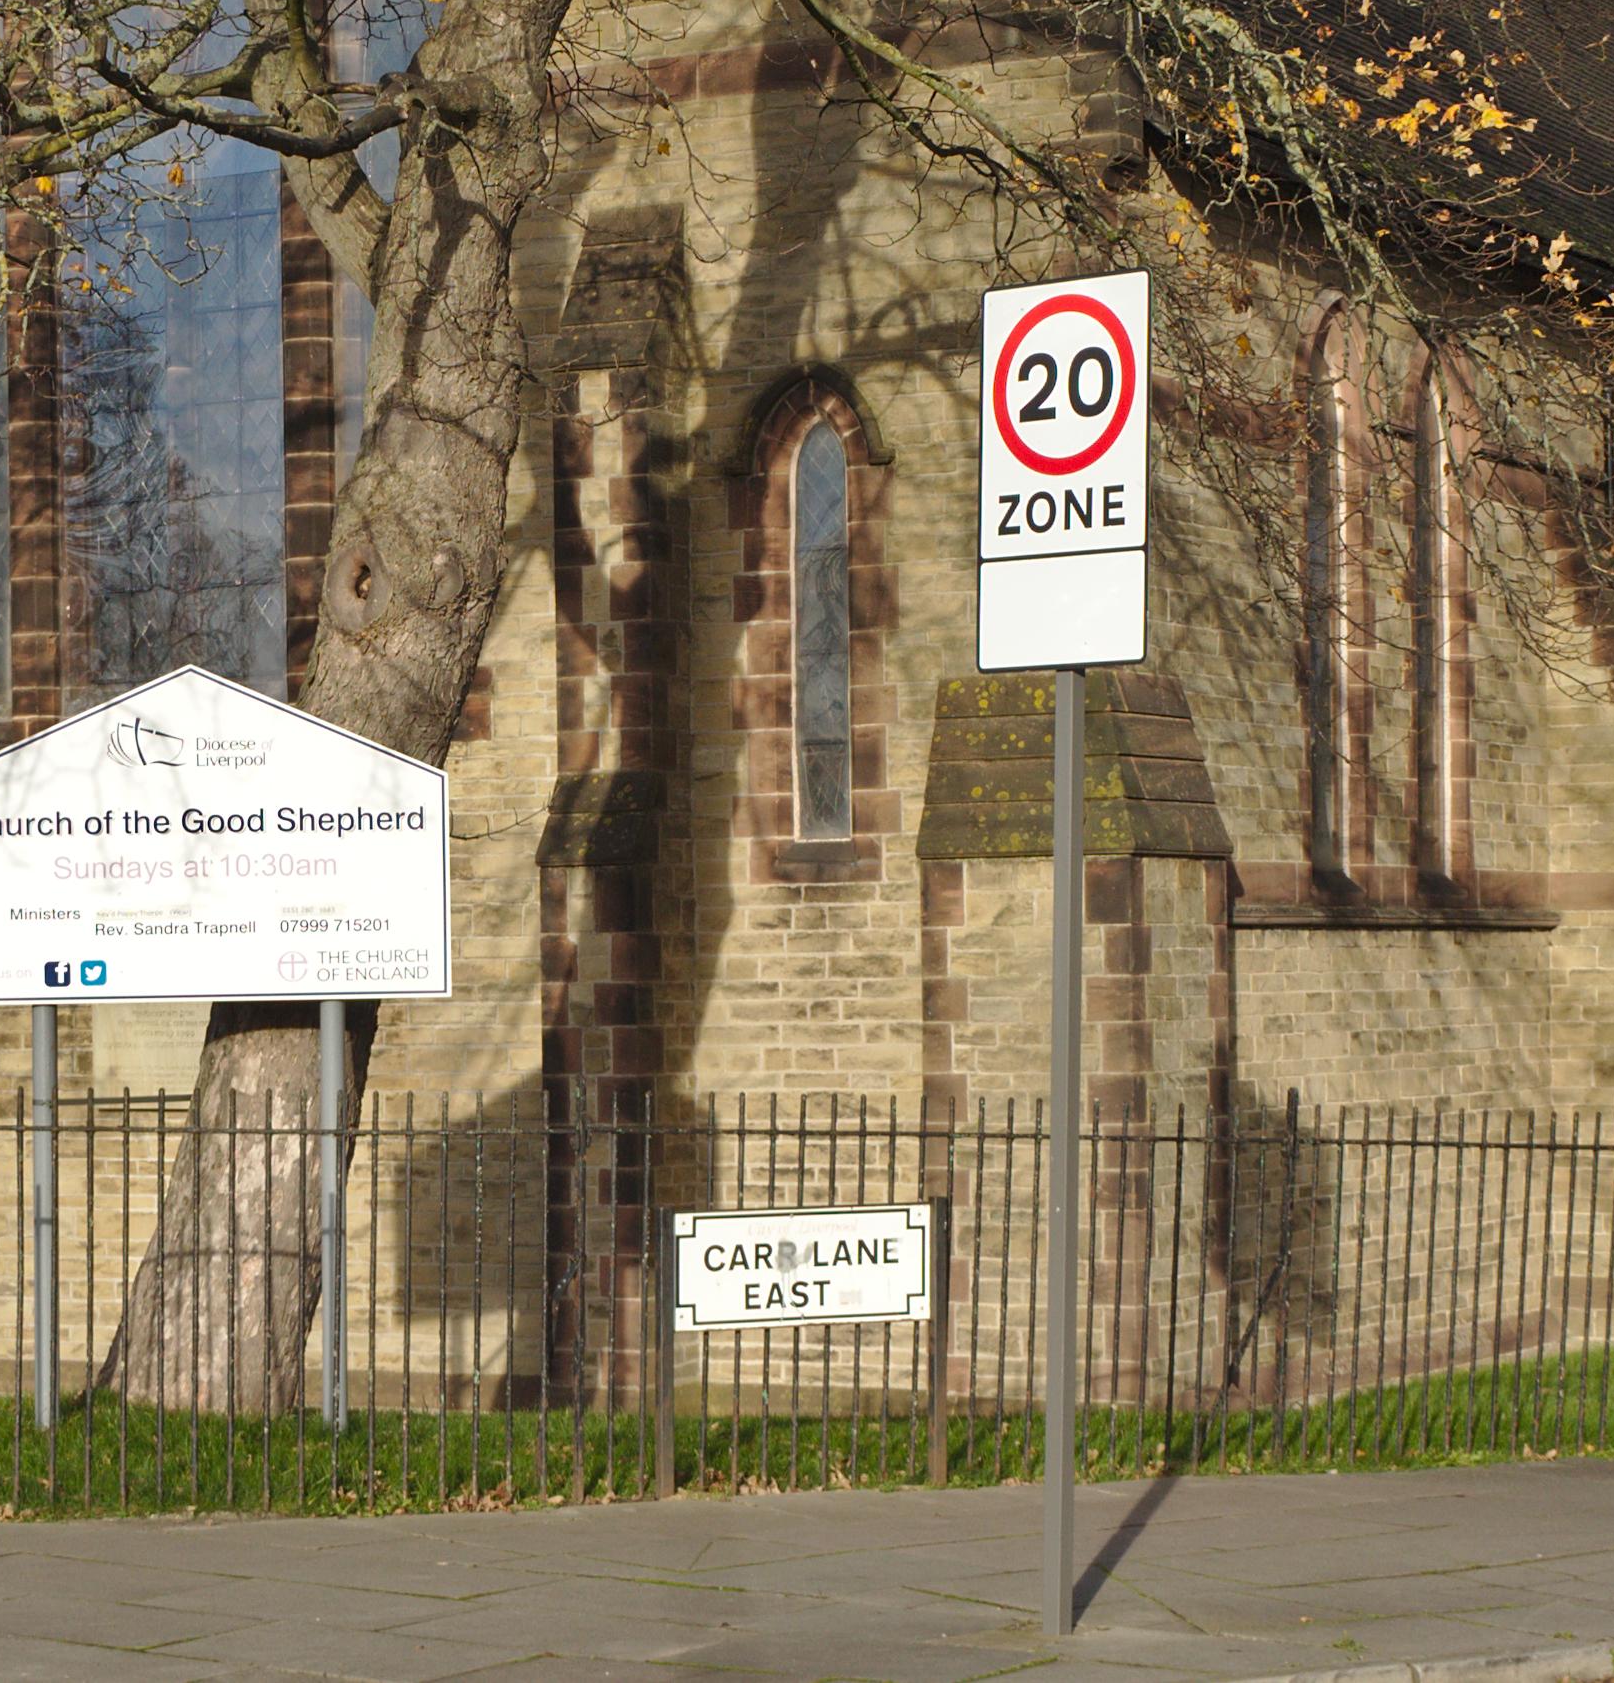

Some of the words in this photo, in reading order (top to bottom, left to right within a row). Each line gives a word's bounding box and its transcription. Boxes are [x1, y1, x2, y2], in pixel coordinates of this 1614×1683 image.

[1017, 346, 1115, 423] 20
[998, 485, 1125, 536] ZONE
[197, 738, 255, 750] Diocese
[197, 753, 265, 769] Liverpool
[85, 810, 112, 835] of
[123, 810, 169, 834] the
[182, 808, 264, 834] Good
[278, 806, 423, 837] Shepherd
[55, 857, 172, 883] Sundays
[184, 857, 208, 878] at
[221, 854, 336, 876] 10:30am
[11, 909, 80, 919] Ministers
[96, 924, 128, 935] Rev.
[135, 923, 188, 935] Sandra
[195, 922, 255, 936] Trapnell
[281, 920, 328, 932] 07999
[335, 919, 388, 931] 715201
[317, 951, 348, 964] THE
[356, 949, 427, 963] CHURCH
[317, 969, 339, 981] OF
[346, 967, 428, 980] ENGLAND
[812, 1238, 899, 1267] LANE
[745, 1280, 830, 1310] EAST
